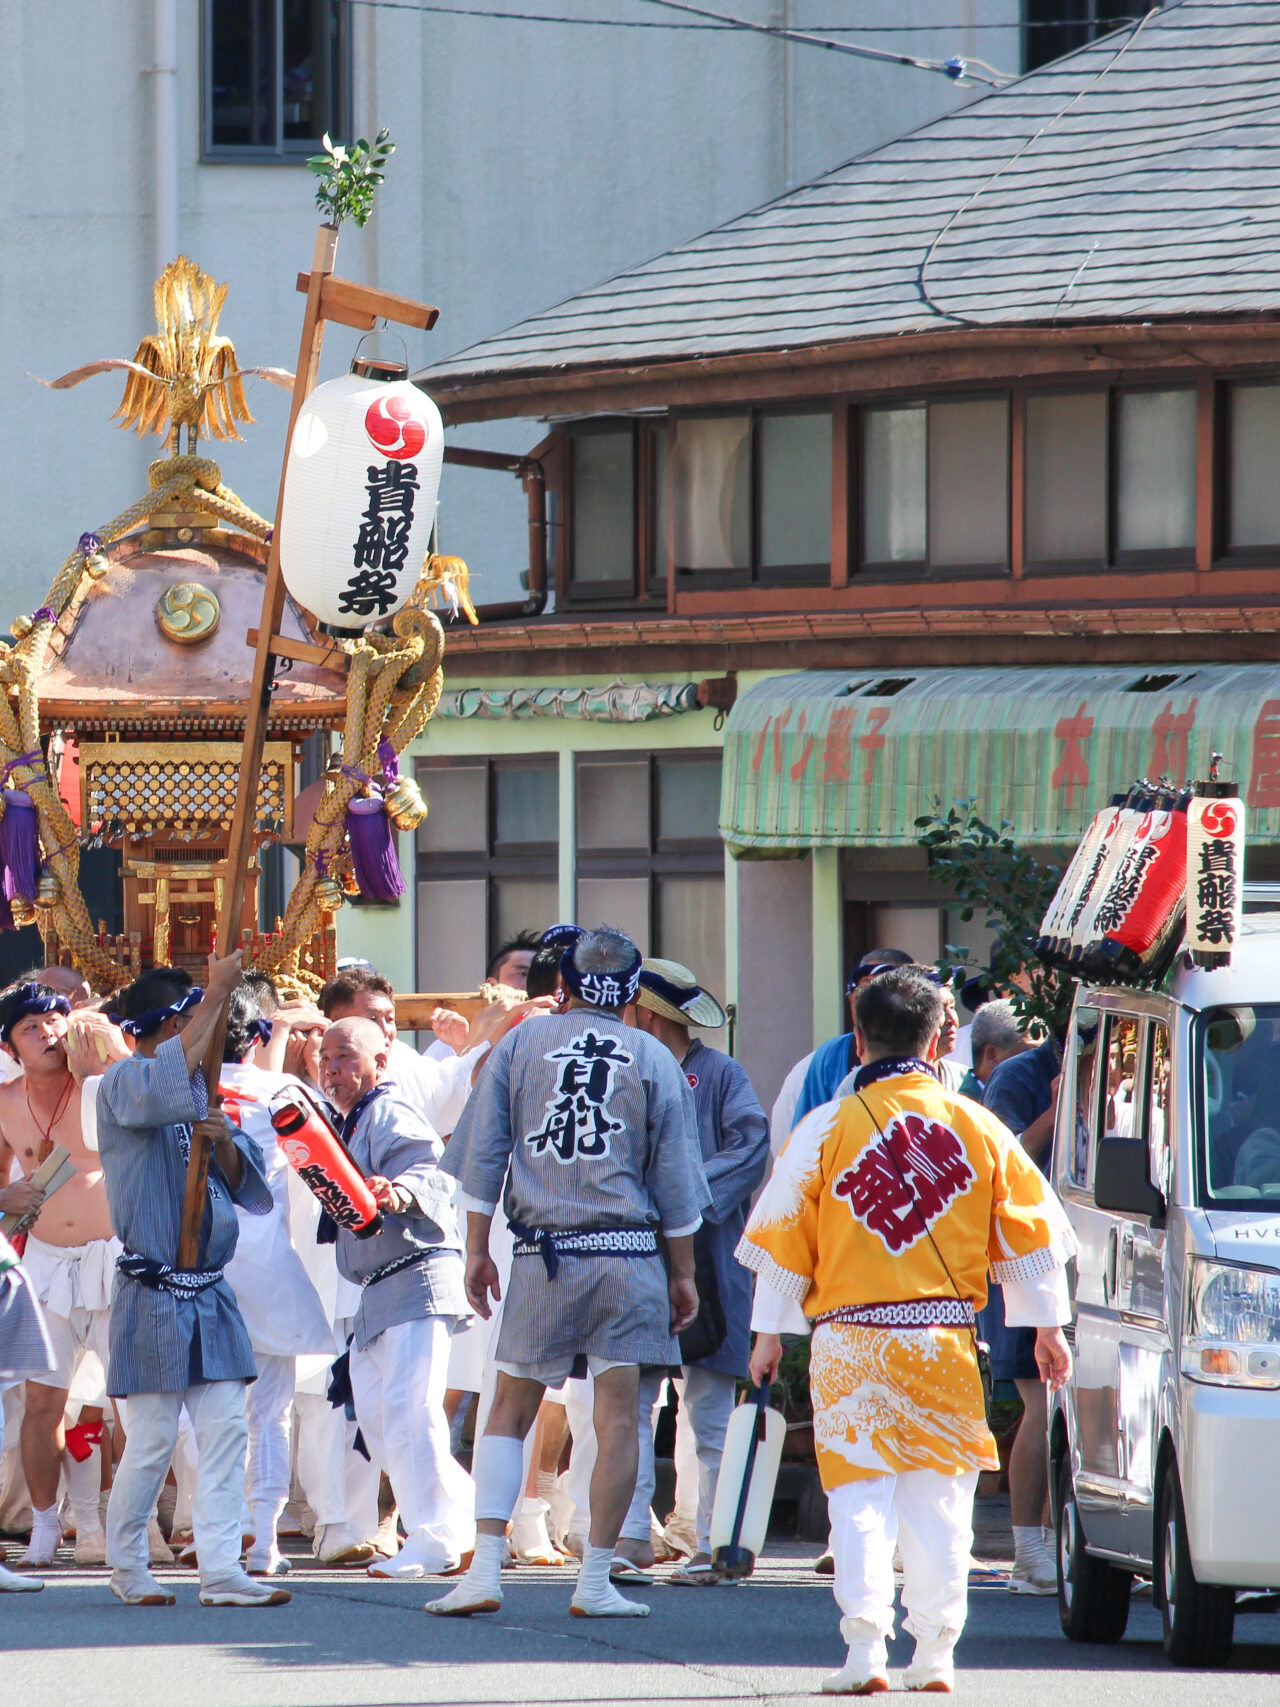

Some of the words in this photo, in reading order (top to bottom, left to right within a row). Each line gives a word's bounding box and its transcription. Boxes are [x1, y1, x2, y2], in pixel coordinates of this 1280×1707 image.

[338, 460, 421, 616] 貴船祭
[753, 705, 892, 785] パン菓子
[1197, 839, 1237, 944] 貴船祭
[526, 1030, 631, 1162] 貴船
